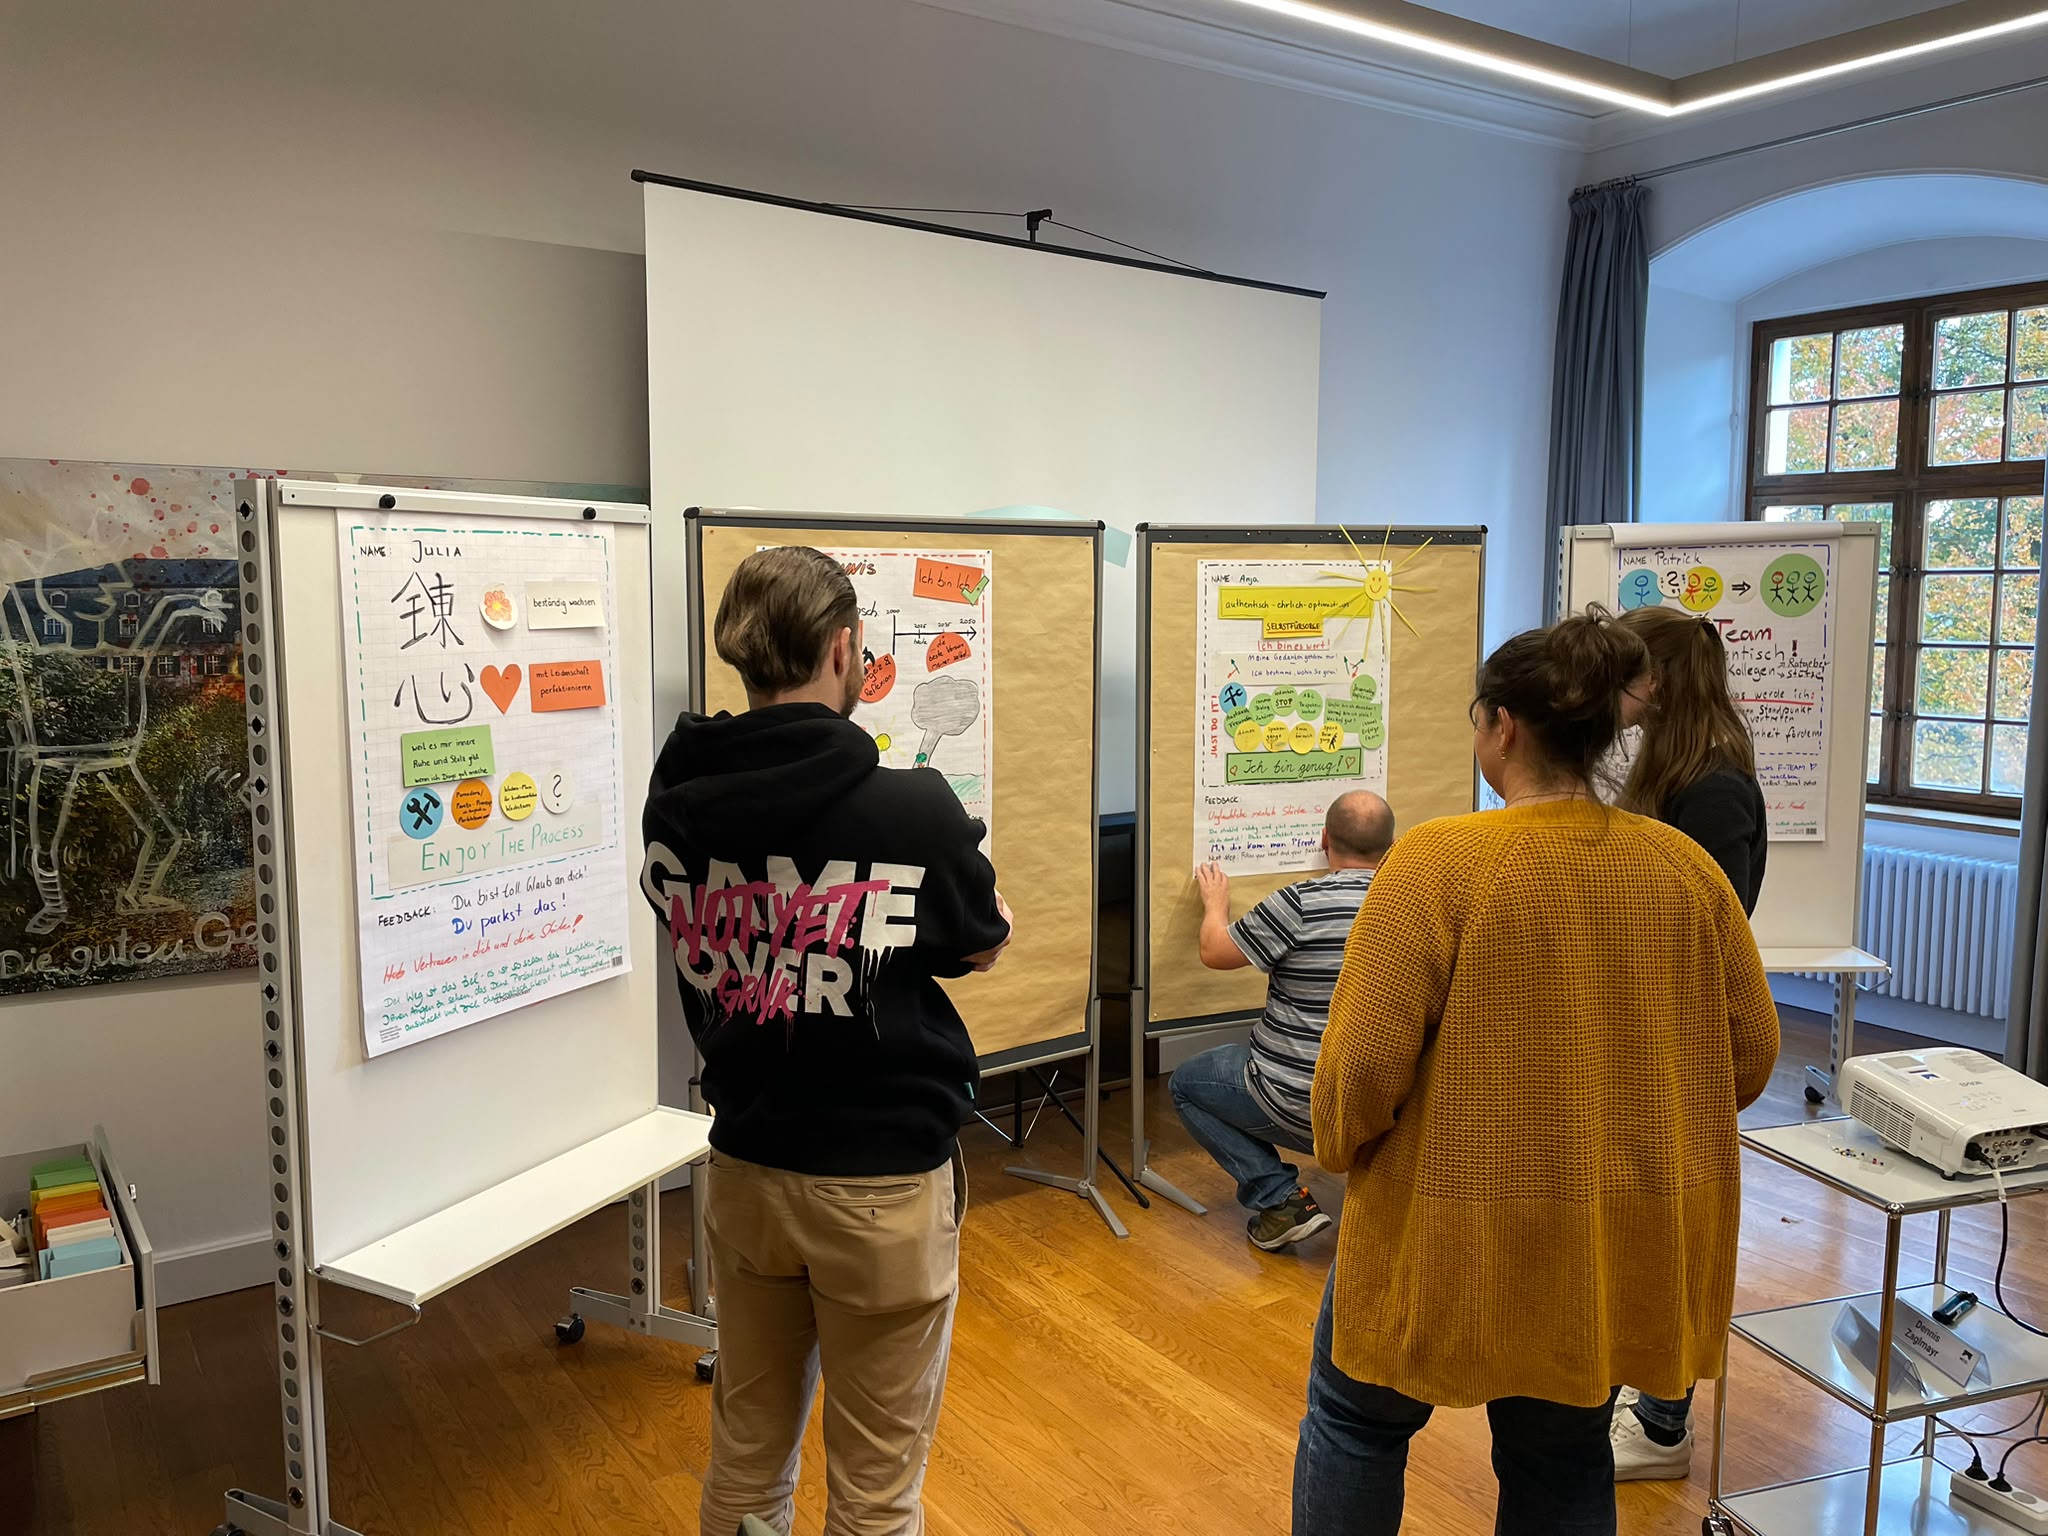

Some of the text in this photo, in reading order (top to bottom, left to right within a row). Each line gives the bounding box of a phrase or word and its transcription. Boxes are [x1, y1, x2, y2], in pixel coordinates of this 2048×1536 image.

[412, 540, 462, 563] JULIA
[1655, 551, 1703, 566] Patrick
[919, 568, 934, 585] Ich
[938, 568, 952, 588] bin
[1240, 574, 1259, 585] Anja
[533, 597, 596, 614] beständig wachsen
[1225, 598, 1269, 609] authentisch
[1258, 640, 1272, 651] Ich
[1724, 644, 1785, 661] entisch
[536, 670, 548, 678] mit
[1276, 698, 1293, 706] STOP
[1755, 689, 1785, 700] werde
[1211, 718, 1218, 731] DO
[412, 742, 426, 752] weil
[413, 760, 430, 768] Ruhe
[433, 756, 448, 766] und
[1243, 755, 1344, 778] Ich bin genug!
[496, 827, 525, 857] THE
[531, 823, 585, 850] PROCESS
[378, 906, 436, 927] FEEDBACK:
[451, 895, 472, 911] Du
[477, 886, 499, 906] bist
[555, 876, 565, 885] an
[640, 841, 926, 948] GAME
[452, 918, 472, 935] Du
[670, 881, 776, 964] NOT
[472, 939, 491, 958] dich
[494, 933, 512, 950] und
[513, 928, 536, 946] deine
[676, 936, 854, 1017] OVER
[441, 981, 457, 994] das
[1915, 1320, 1941, 1342] Dennis
[1904, 1328, 1939, 1357] Zaglmayr
